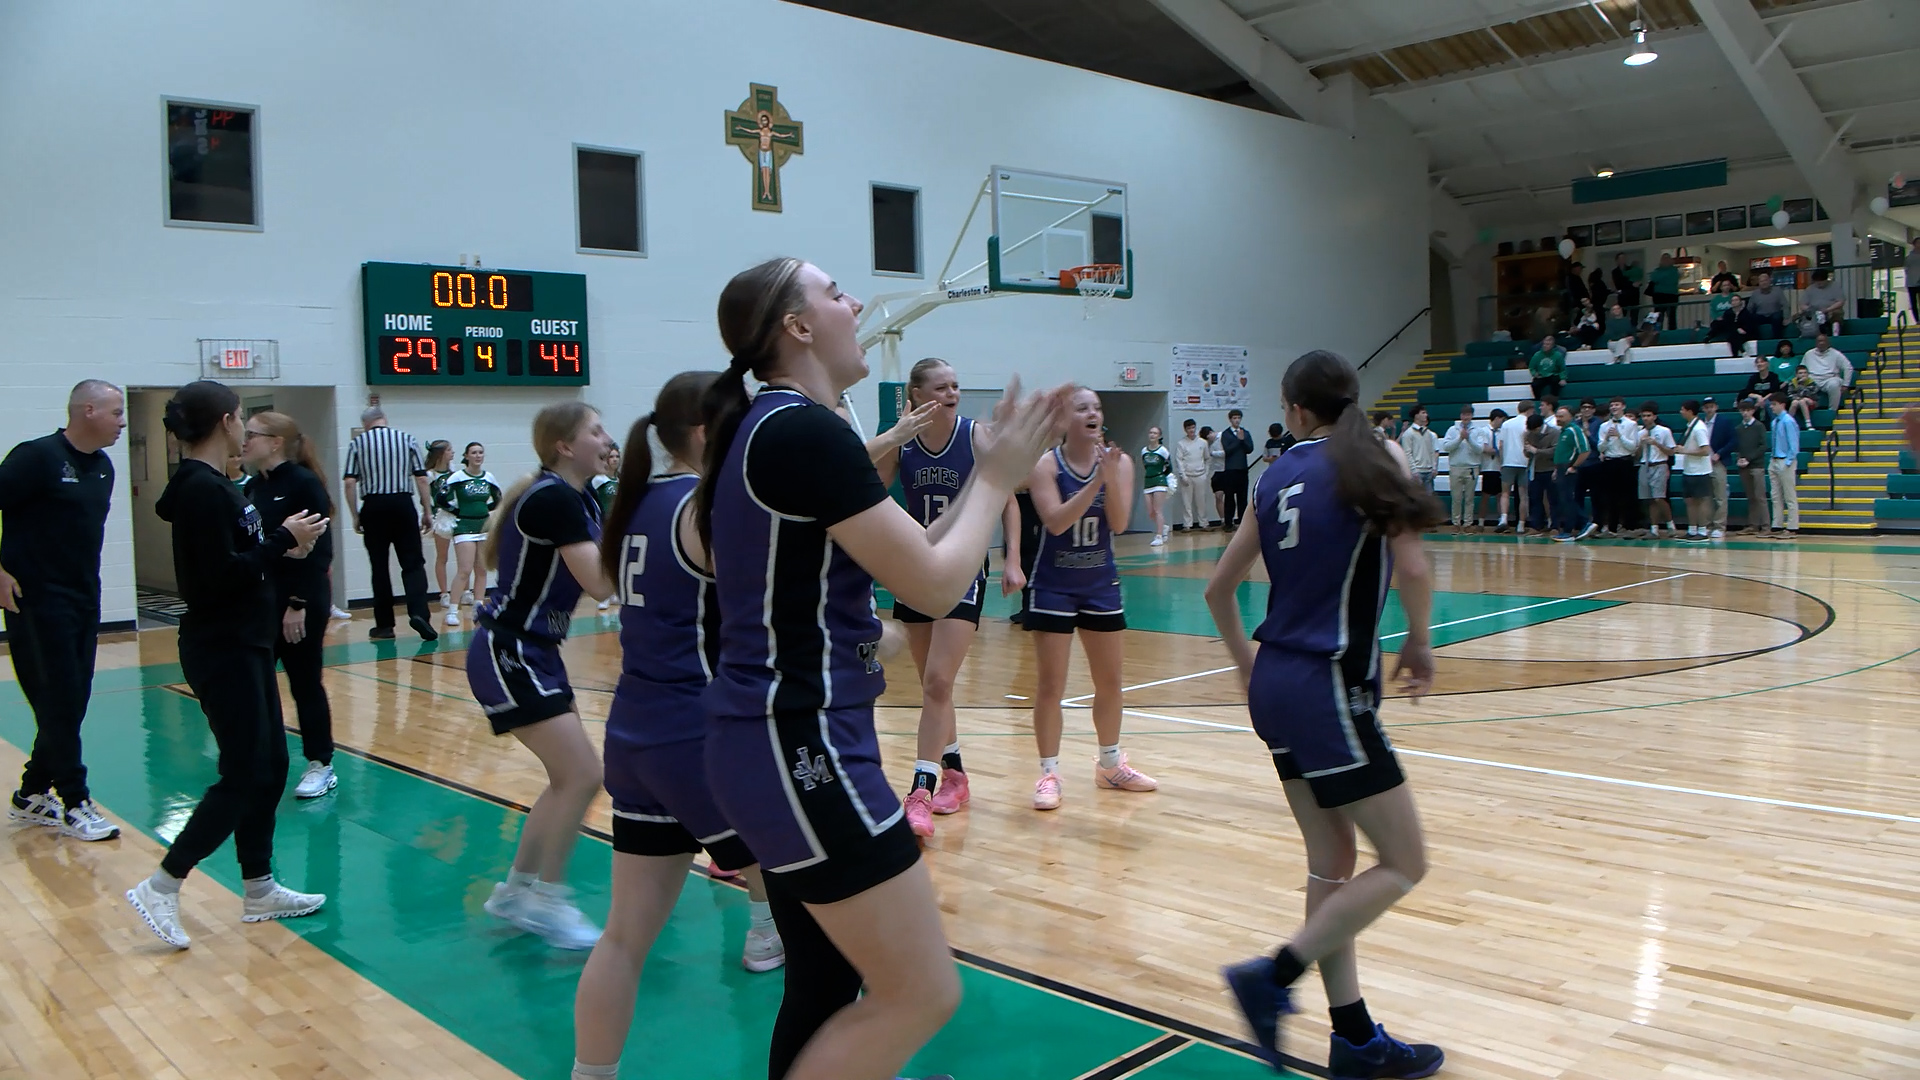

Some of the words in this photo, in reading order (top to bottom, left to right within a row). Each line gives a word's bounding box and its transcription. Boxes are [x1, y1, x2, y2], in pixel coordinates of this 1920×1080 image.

[433, 272, 508, 309] 00.0
[947, 288, 981, 299] Charleston
[384, 313, 433, 332] HOME
[465, 326, 504, 339] PERIOD
[531, 318, 579, 336] GUEST
[225, 350, 249, 367] EXIT
[393, 337, 437, 373] 29
[477, 345, 493, 368] 4
[540, 343, 580, 373] 44
[912, 466, 959, 489] JAMES
[1277, 482, 1305, 550] 5
[1072, 516, 1100, 548] 10
[618, 534, 648, 608] 12
